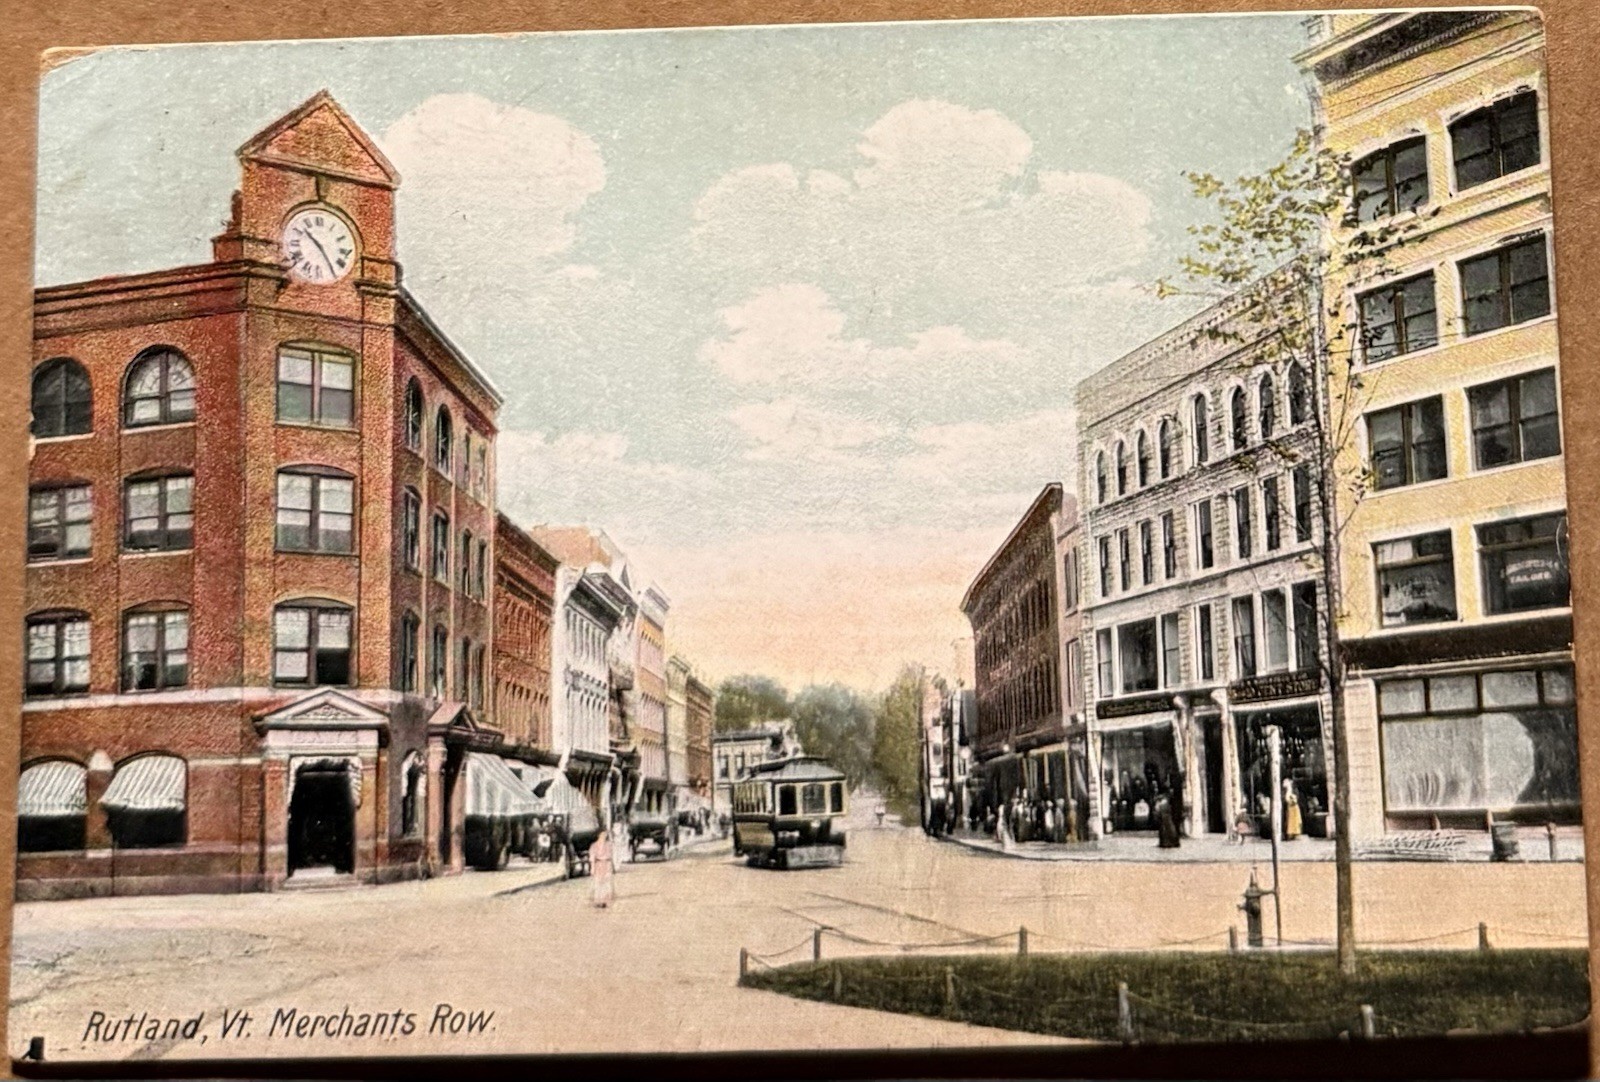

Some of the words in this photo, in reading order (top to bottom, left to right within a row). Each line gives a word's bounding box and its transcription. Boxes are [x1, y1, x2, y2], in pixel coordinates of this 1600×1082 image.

[83, 1011, 208, 1045] Rutland,
[221, 1011, 253, 1039] Vt.
[269, 1006, 417, 1038] Merchants
[429, 1003, 496, 1034] Row.
